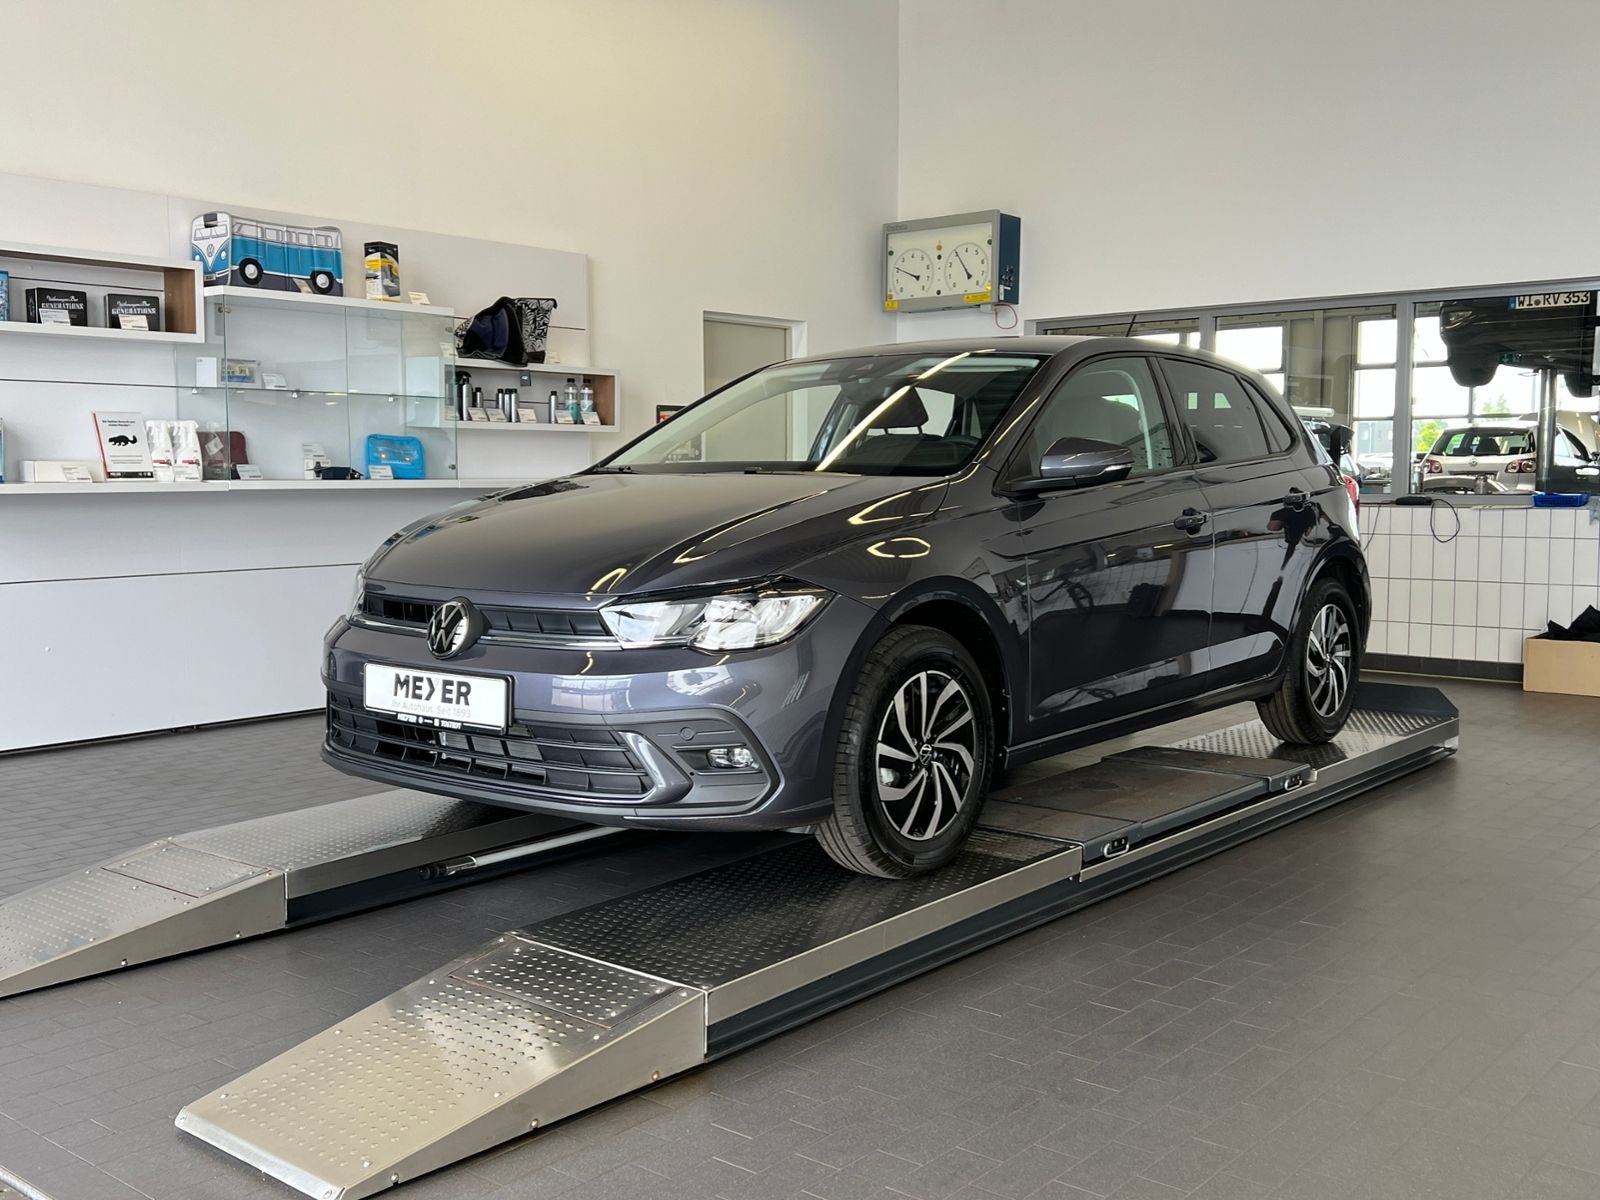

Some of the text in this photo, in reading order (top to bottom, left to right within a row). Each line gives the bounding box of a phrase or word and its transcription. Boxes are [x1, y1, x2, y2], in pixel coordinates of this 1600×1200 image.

[1518, 291, 1589, 307] WI RV 353
[41, 302, 84, 310] GENERATIONS
[111, 306, 156, 315] GENERATIONS
[394, 673, 472, 706] MEYER
